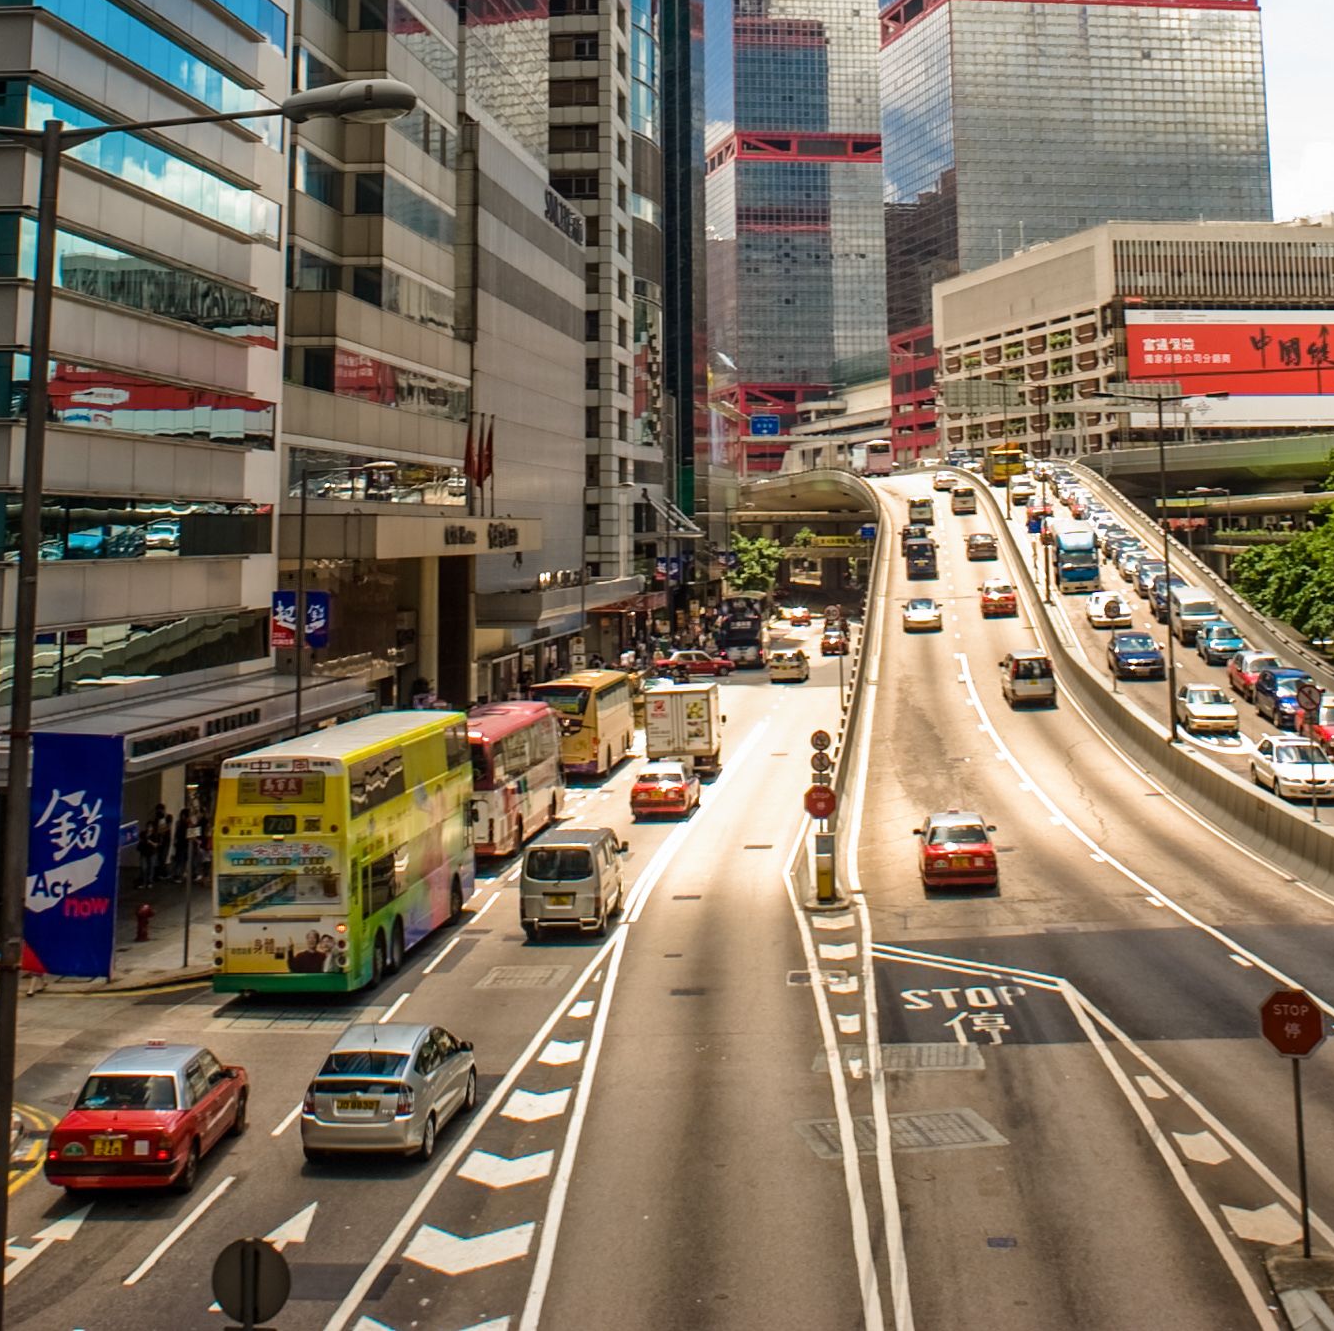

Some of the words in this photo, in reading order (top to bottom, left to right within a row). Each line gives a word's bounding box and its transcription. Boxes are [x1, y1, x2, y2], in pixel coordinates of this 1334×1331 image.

[30, 872, 72, 899] Act
[63, 897, 109, 918] now
[900, 985, 1026, 1011] STOP
[1272, 1003, 1310, 1017] STOP
[943, 1011, 1012, 1046] 停
